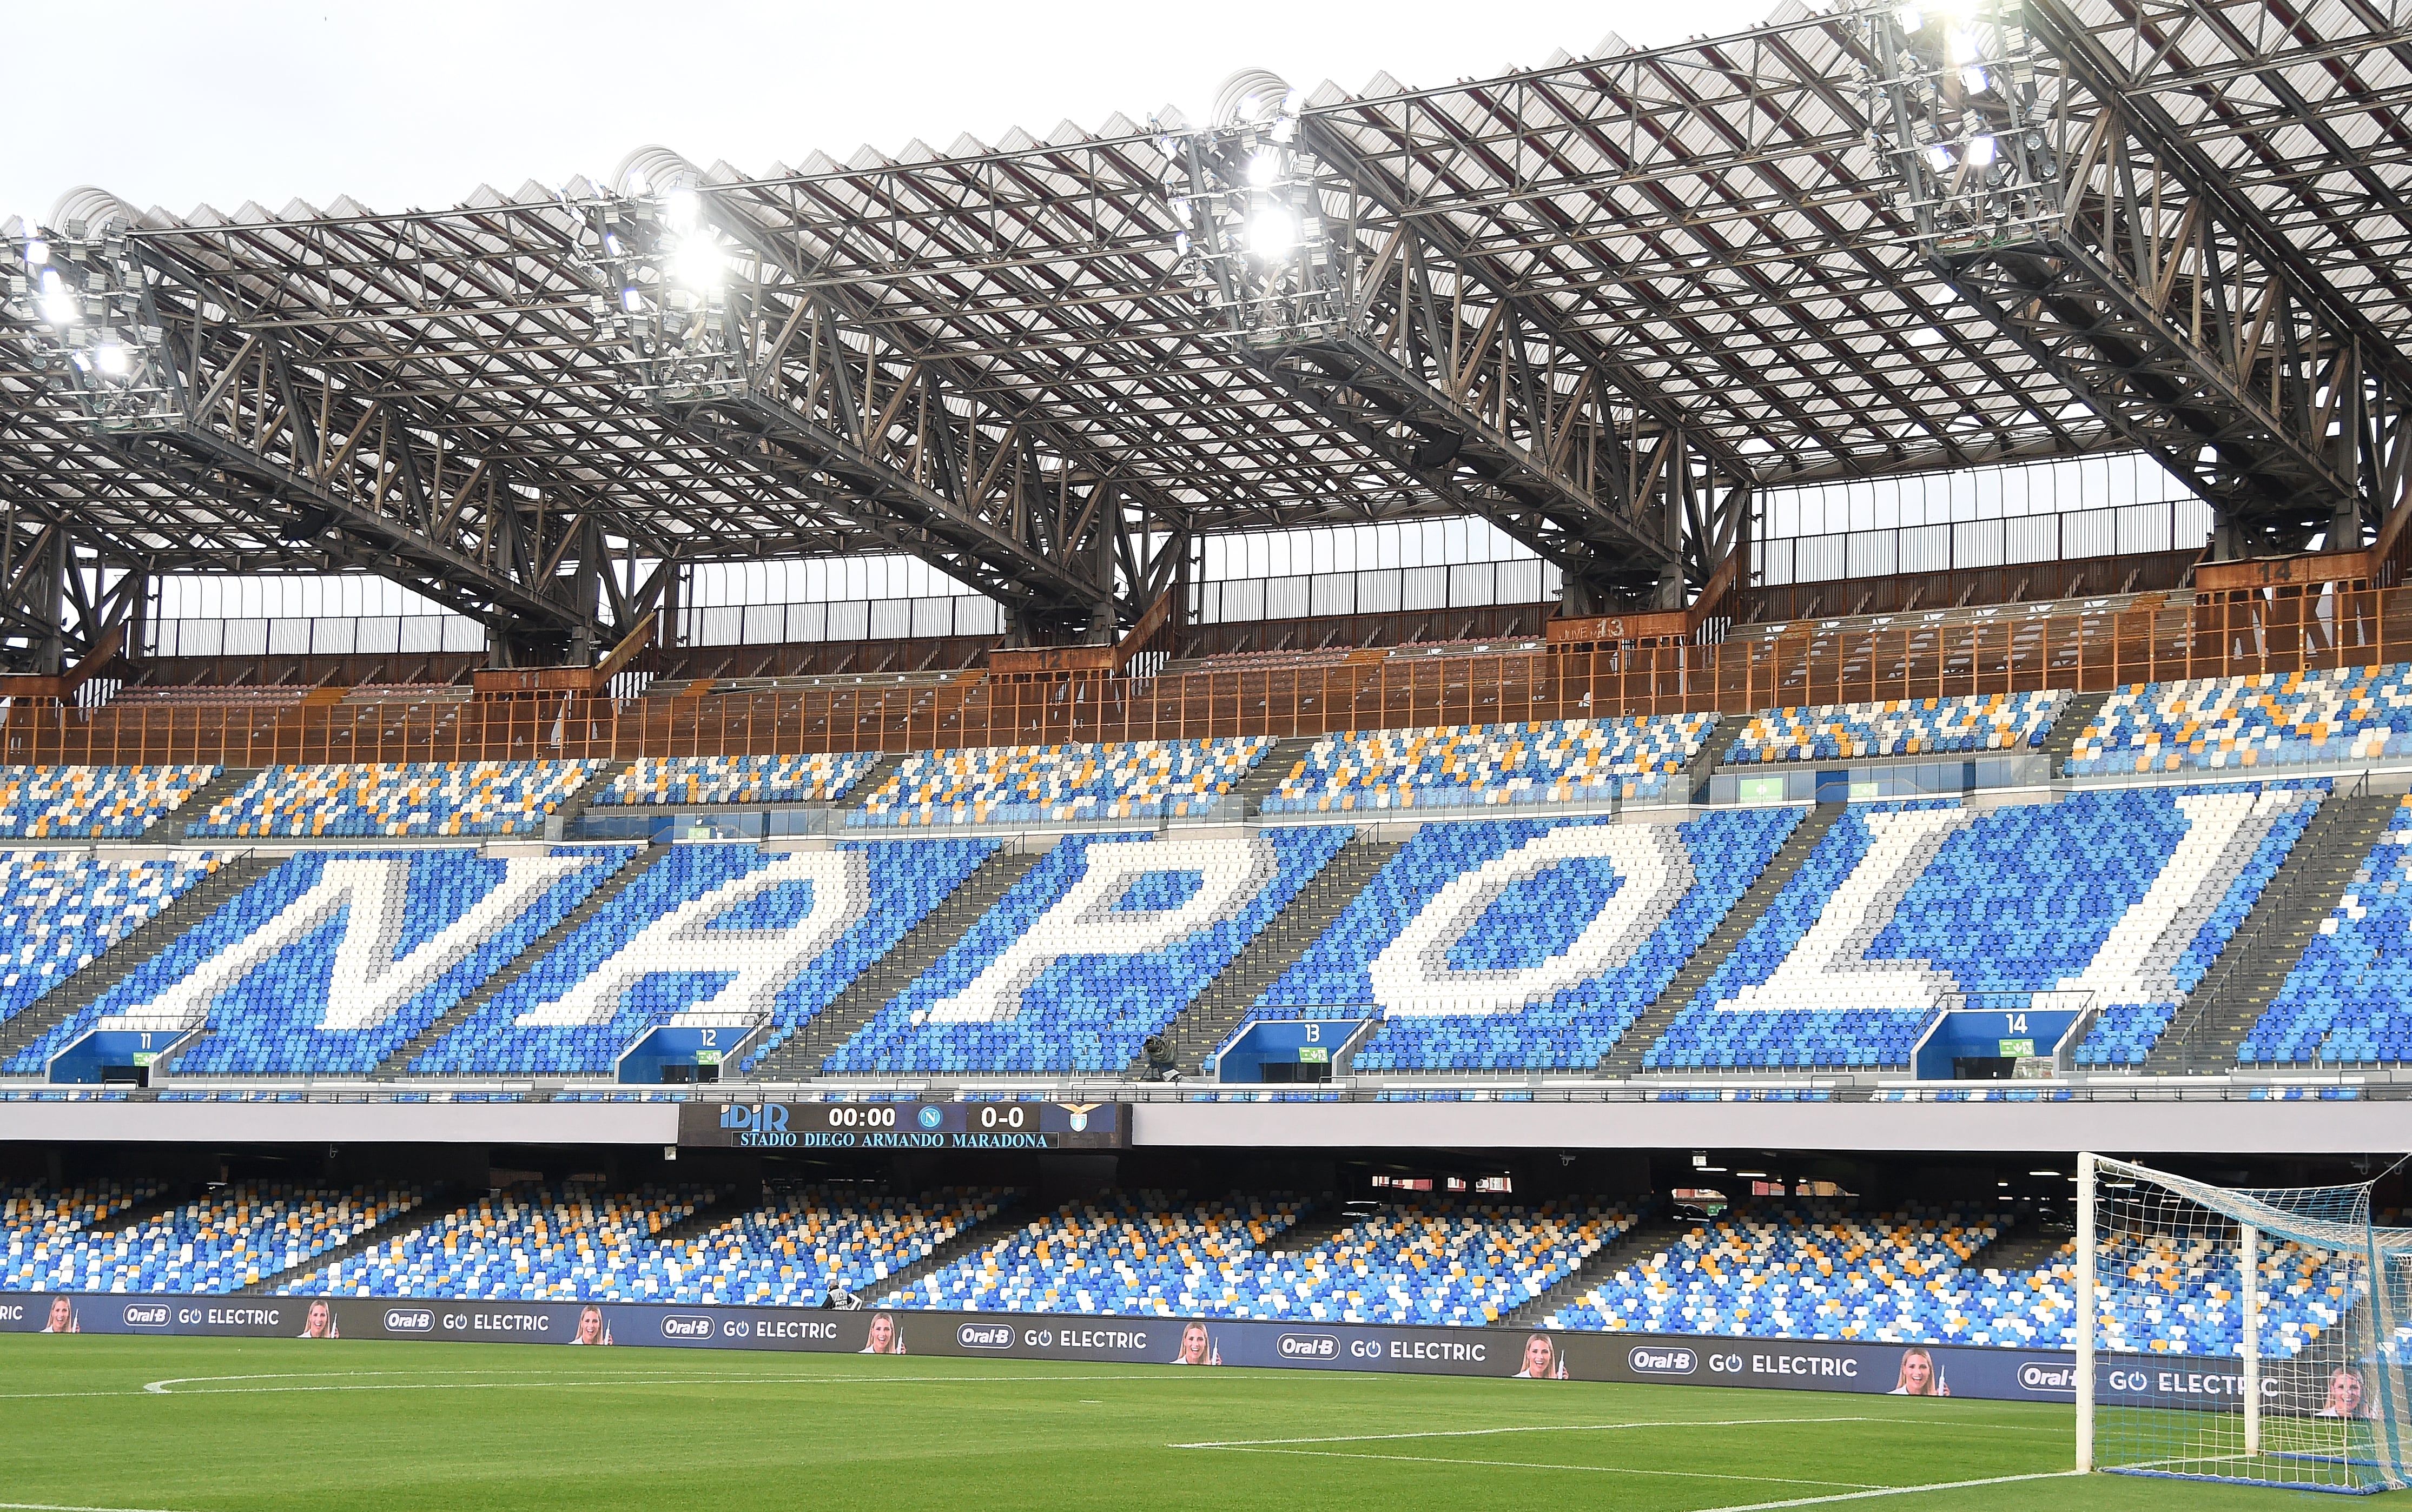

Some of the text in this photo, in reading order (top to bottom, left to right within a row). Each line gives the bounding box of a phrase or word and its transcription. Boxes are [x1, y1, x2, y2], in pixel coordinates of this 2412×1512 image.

[2258, 560, 2292, 583] 14
[1597, 618, 1624, 637] 13
[1038, 651, 1062, 669] 12
[519, 672, 539, 688] 11
[97, 787, 2329, 1031] NAPOLI
[2005, 1013, 2028, 1034] 14
[141, 1032, 151, 1050] 11
[701, 1029, 717, 1046] 12
[1304, 1024, 1320, 1043] 13
[829, 1107, 896, 1127] 00:00
[981, 1106, 1024, 1128] 0-0
[741, 1133, 1048, 1148] STADIO DIEGO ARMANDO MARADONA
[127, 1308, 166, 1322] Oral-B
[208, 1309, 279, 1325] ELECTRIC
[388, 1313, 429, 1327] Oral-B
[474, 1314, 549, 1331] ELECTRIC
[666, 1319, 709, 1335] Oral-B
[757, 1321, 837, 1339] ELECTRIC
[962, 1328, 1009, 1344] Oral-B
[1060, 1330, 1147, 1349] ELECTRIC
[1282, 1338, 1334, 1355] Oral-B
[1390, 1341, 1486, 1362] ELECTRIC
[1634, 1351, 1690, 1369] Oral-B
[1753, 1355, 1858, 1377] ELECTRIC
